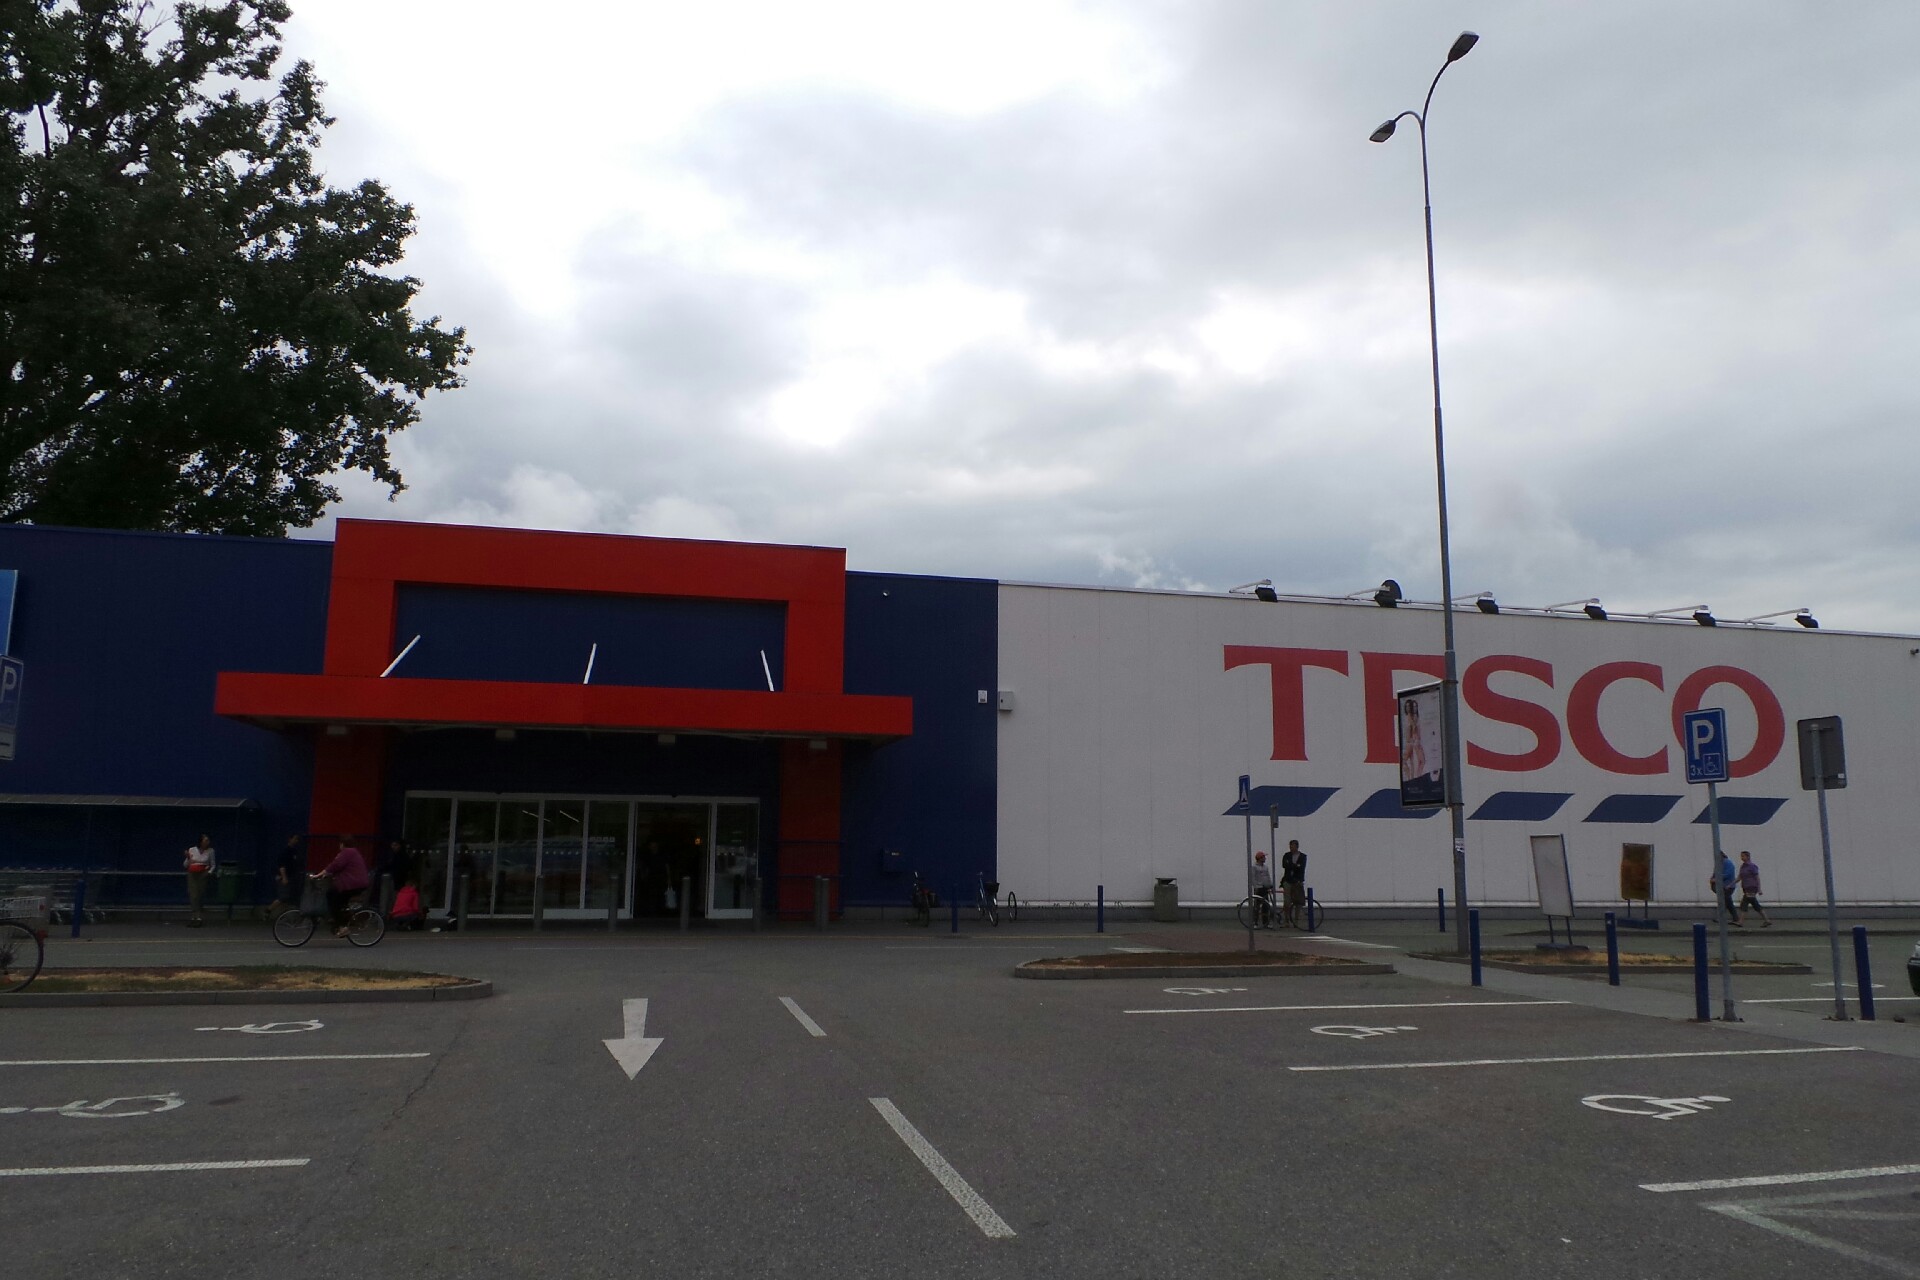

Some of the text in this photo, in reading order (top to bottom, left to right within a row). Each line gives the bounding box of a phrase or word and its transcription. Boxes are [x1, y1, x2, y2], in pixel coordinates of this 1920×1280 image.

[0, 666, 16, 703] P
[1224, 645, 1784, 778] TESCO
[1692, 720, 1714, 760] P
